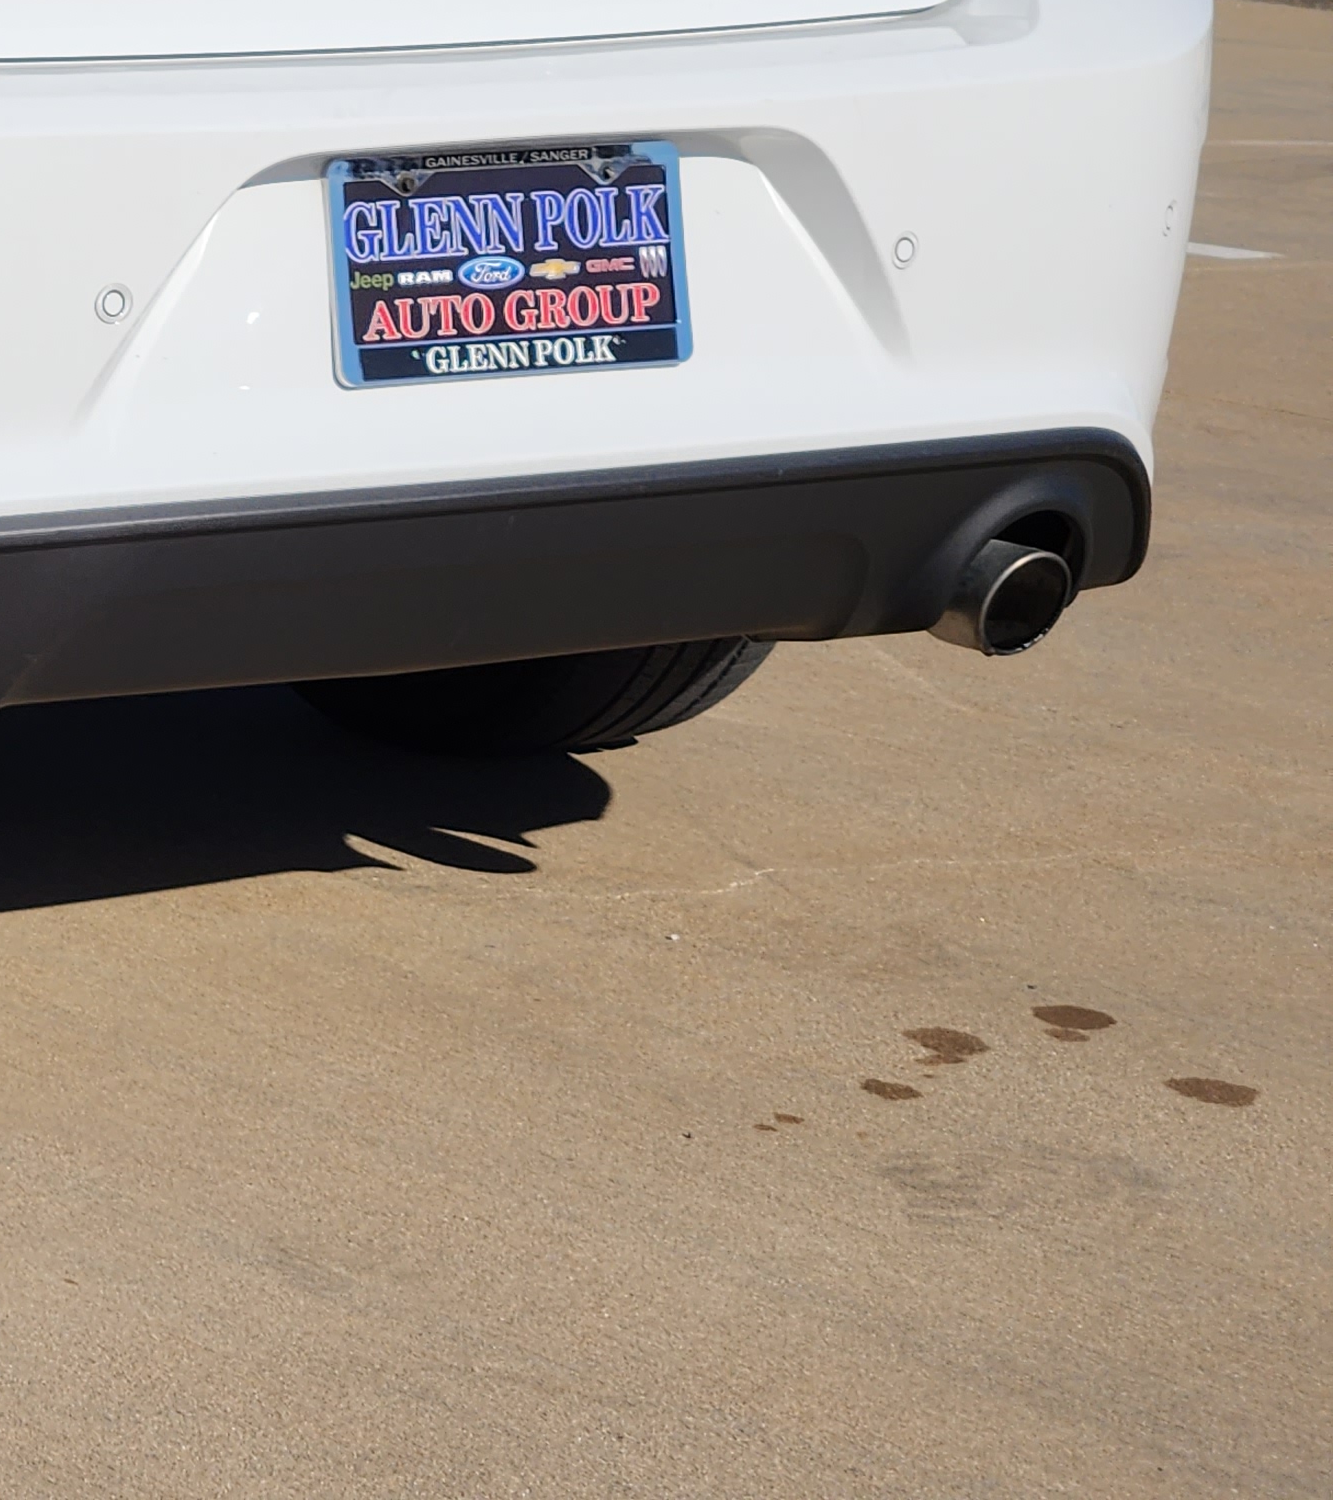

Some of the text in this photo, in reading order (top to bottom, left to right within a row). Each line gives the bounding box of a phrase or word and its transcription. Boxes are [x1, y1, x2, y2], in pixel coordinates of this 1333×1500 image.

[424, 151, 518, 169] GAINESVILLE
[529, 148, 589, 162] SANGER
[343, 184, 672, 265] GLENN POLK
[349, 257, 636, 291] Jeep RAM Ford GMC
[362, 282, 661, 342] AUTO GROUP
[425, 334, 618, 375] GLENN POLK
